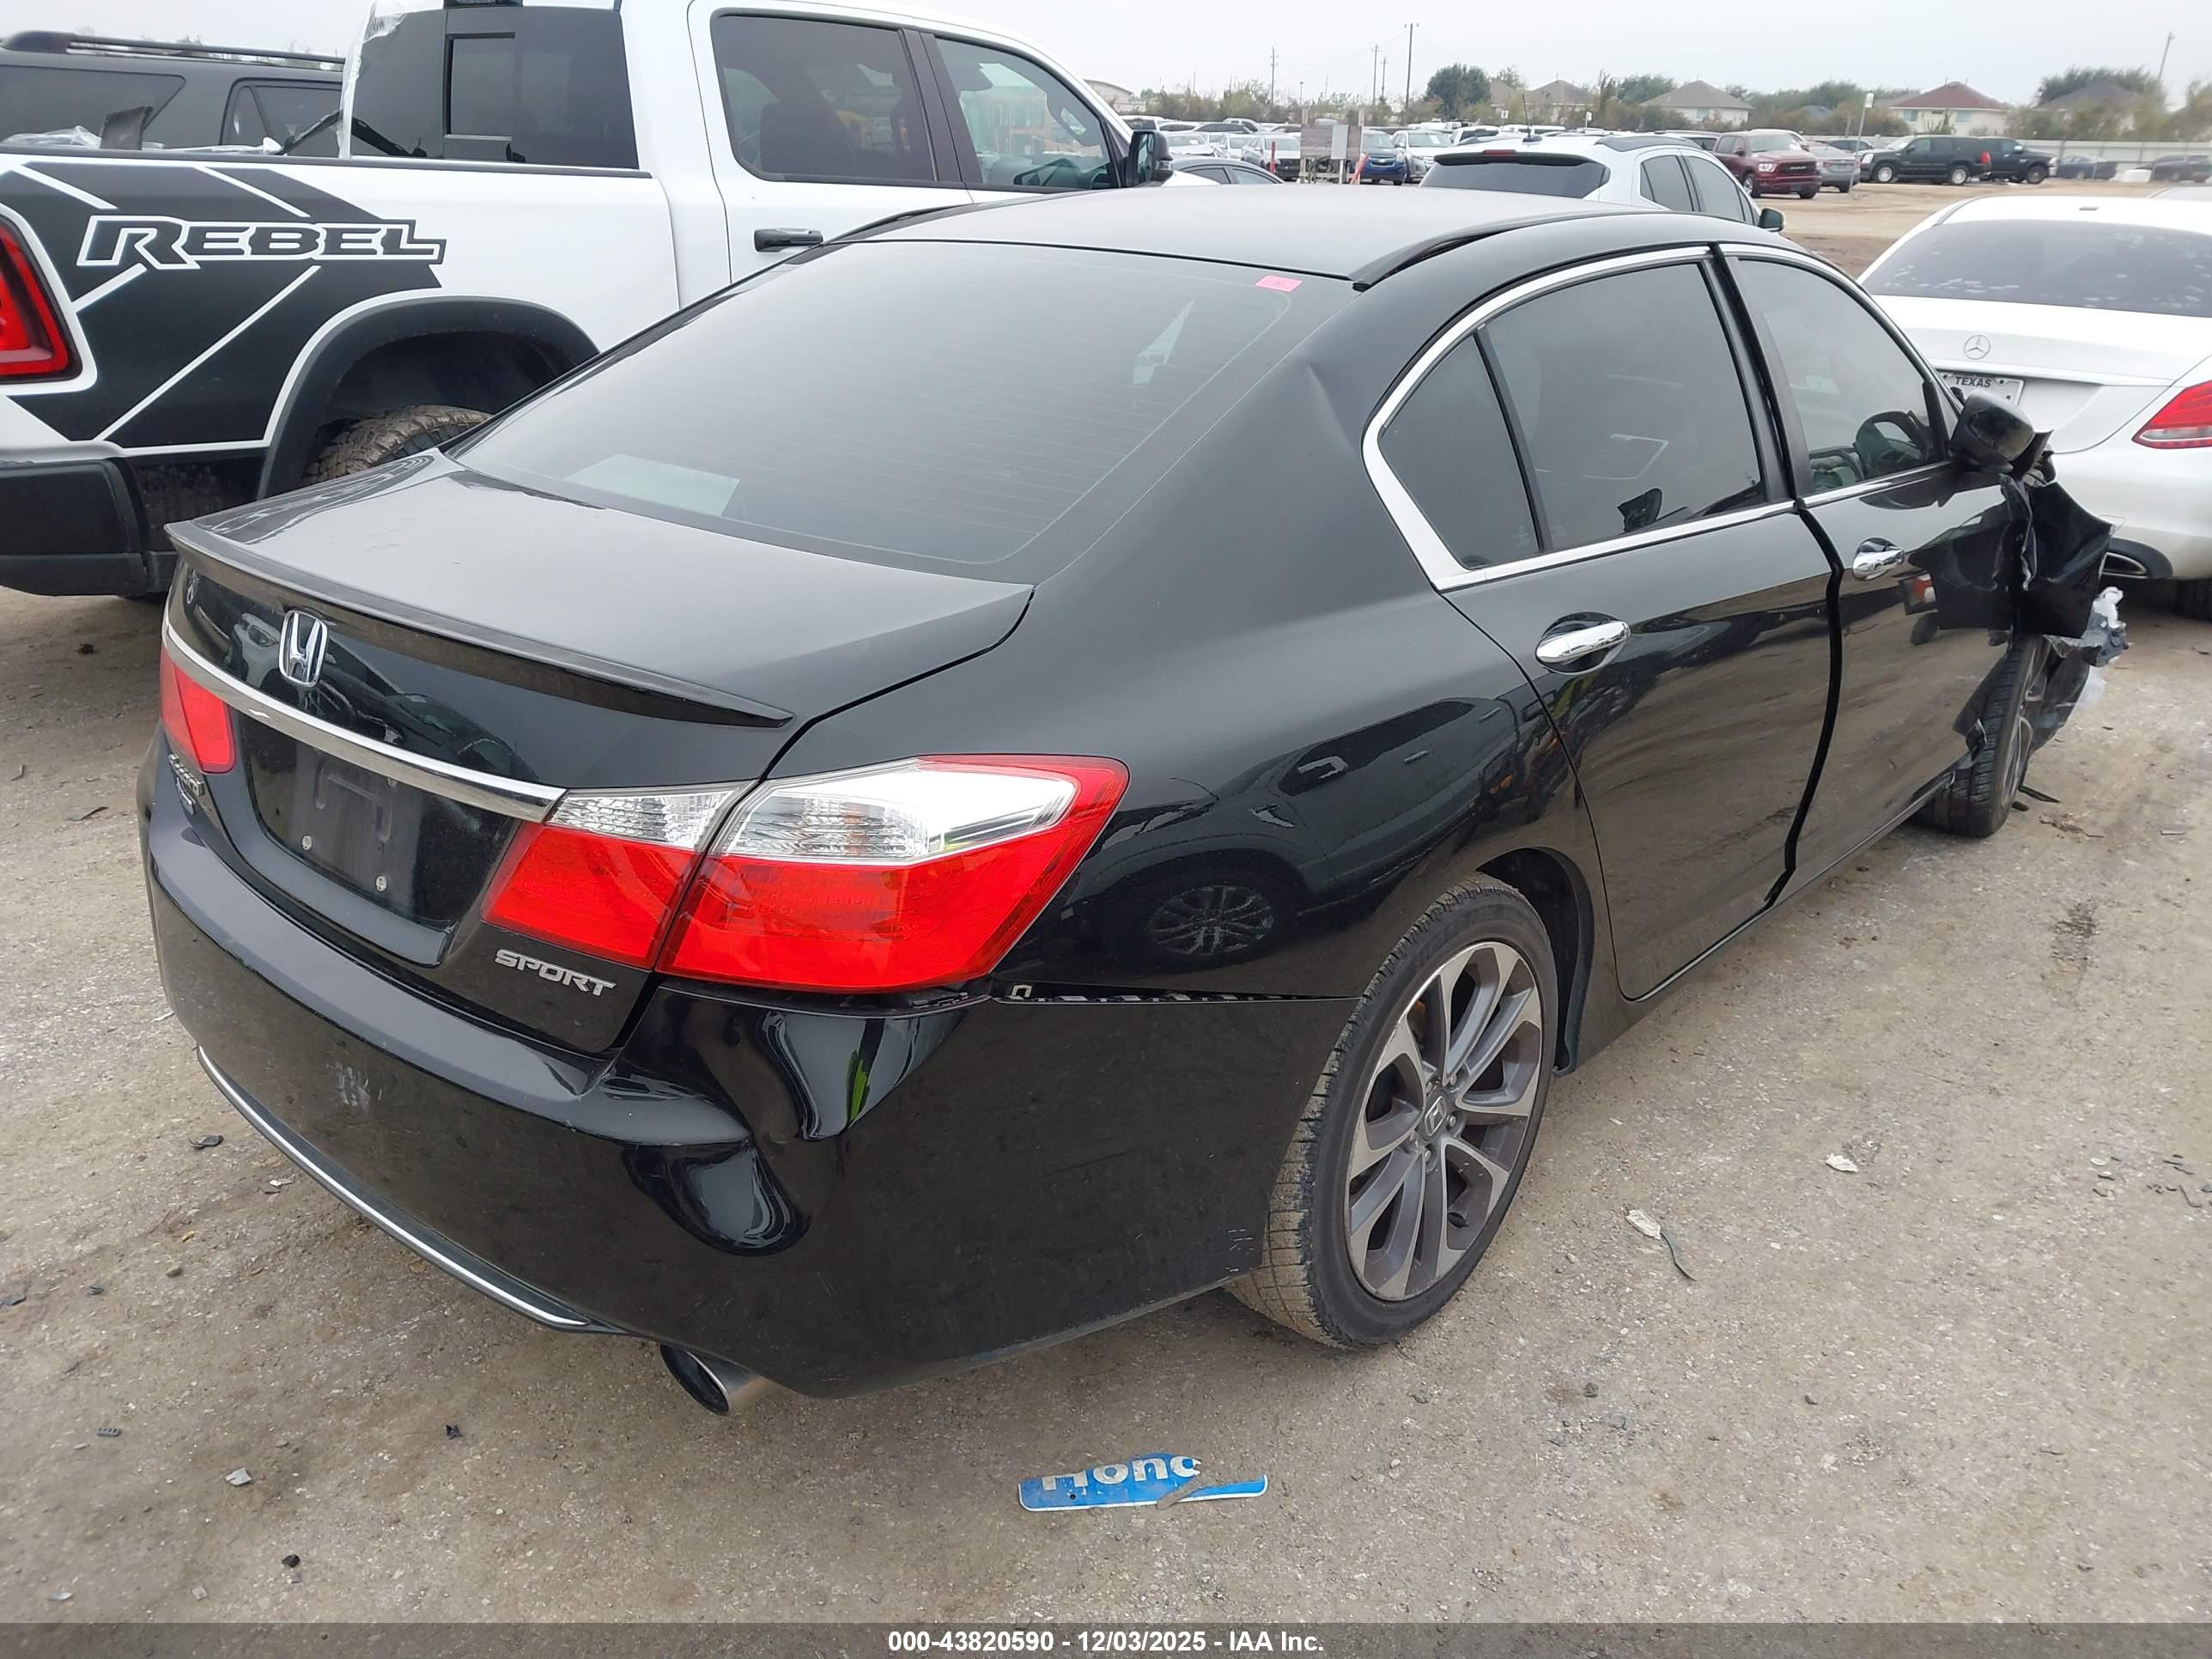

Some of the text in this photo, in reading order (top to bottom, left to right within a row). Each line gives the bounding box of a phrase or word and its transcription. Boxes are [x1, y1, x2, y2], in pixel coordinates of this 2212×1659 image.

[77, 216, 441, 270] REBEL
[1955, 376, 1992, 388] TEXAS
[495, 949, 617, 997] SPORT
